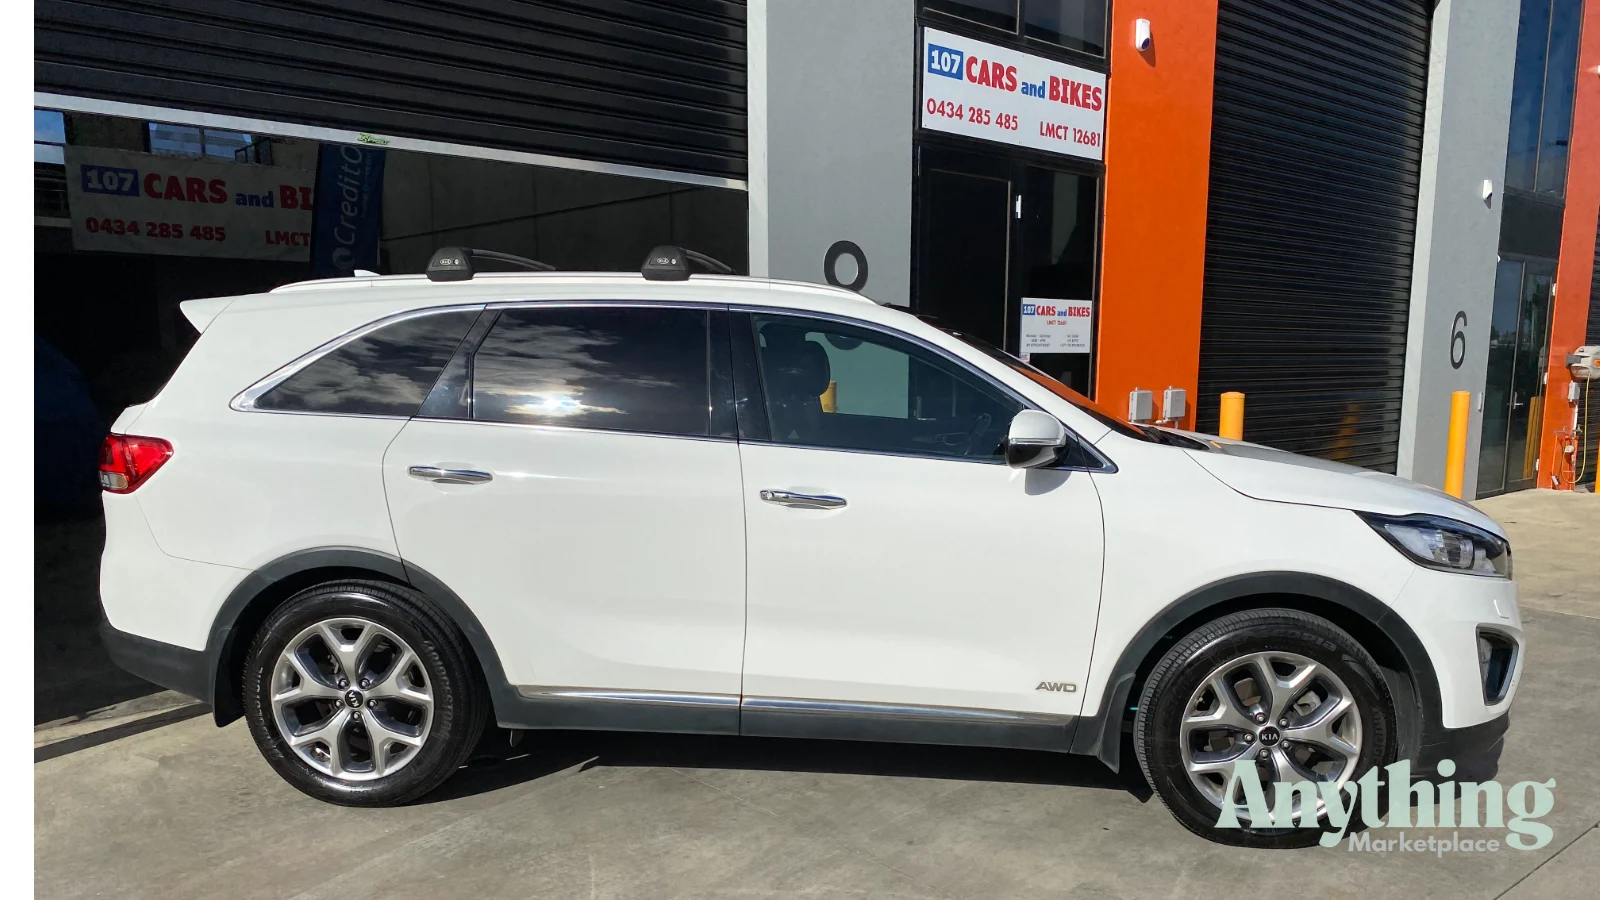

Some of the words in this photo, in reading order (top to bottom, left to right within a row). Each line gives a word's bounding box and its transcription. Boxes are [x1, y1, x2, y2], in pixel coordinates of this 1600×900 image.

[931, 50, 961, 74] 107
[966, 56, 1018, 92] CARS
[1021, 81, 1046, 99] and
[1049, 75, 1102, 111] BIKES
[927, 98, 964, 120] 0434
[968, 107, 991, 126] 285
[995, 113, 1018, 131] 485
[1039, 121, 1069, 141] LMCT
[1073, 128, 1101, 147] 12681
[86, 169, 134, 192] 107
[143, 173, 228, 204] CARS
[235, 190, 275, 208] and
[85, 216, 140, 236] 0434
[145, 221, 184, 239] 285
[190, 225, 226, 242] 485
[264, 230, 311, 247] LMCT
[1023, 305, 1035, 314] 107
[1036, 305, 1056, 316] CARS
[1057, 309, 1067, 317] and
[1068, 306, 1090, 317] BIKES
[1450, 310, 1467, 370] 6
[348, 691, 360, 707] KIA
[1035, 681, 1077, 693] AWD
